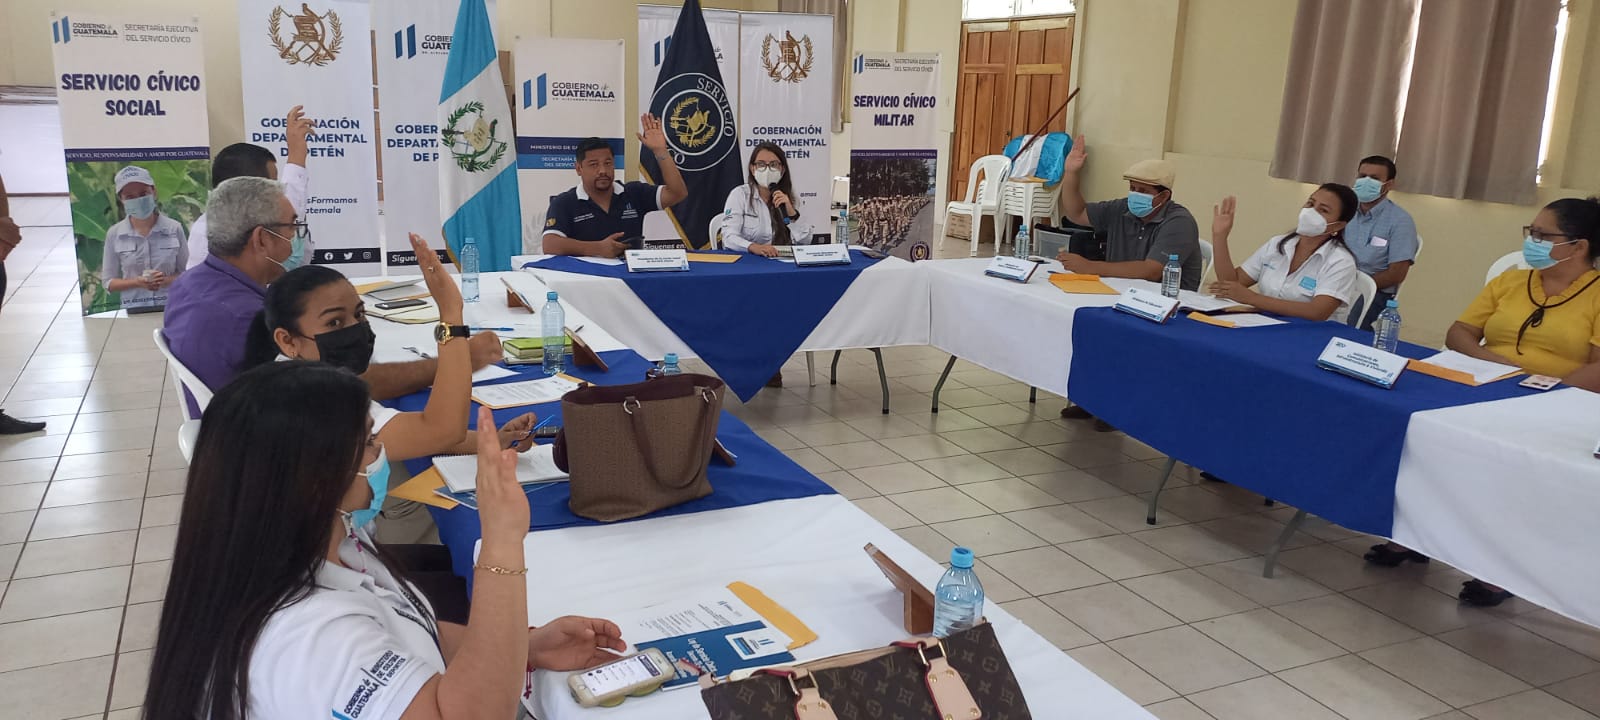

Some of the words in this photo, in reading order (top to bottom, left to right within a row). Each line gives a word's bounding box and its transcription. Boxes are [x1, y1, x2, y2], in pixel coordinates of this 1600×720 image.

[124, 23, 165, 32] SECRETARÍA
[166, 25, 199, 33] EJECUTIVA
[126, 34, 139, 42] DEL
[170, 34, 191, 43] CÍVICO
[61, 73, 141, 91] SERVICIO
[147, 70, 200, 91] CÍVICO
[552, 82, 599, 90] GOBIERNO
[552, 89, 615, 98] GUATEMALA
[854, 95, 900, 108] SERVICIO
[903, 92, 936, 108] CÍVICO
[105, 99, 166, 116] SOCIAL
[697, 77, 735, 137] SERVICIO
[261, 117, 360, 129] GOBNACIÓN
[874, 114, 915, 126] MILITAR
[752, 124, 822, 135] GOBERNACIÓN
[252, 132, 367, 143] DEPAAMENTAL
[387, 138, 439, 148] DEPART
[745, 138, 827, 147] DEPRTAMENTAL
[413, 152, 430, 162] DE
[376, 671, 385, 679] DE
[344, 684, 366, 714] GOBIERNO
[350, 682, 380, 719] GUATEMALA
